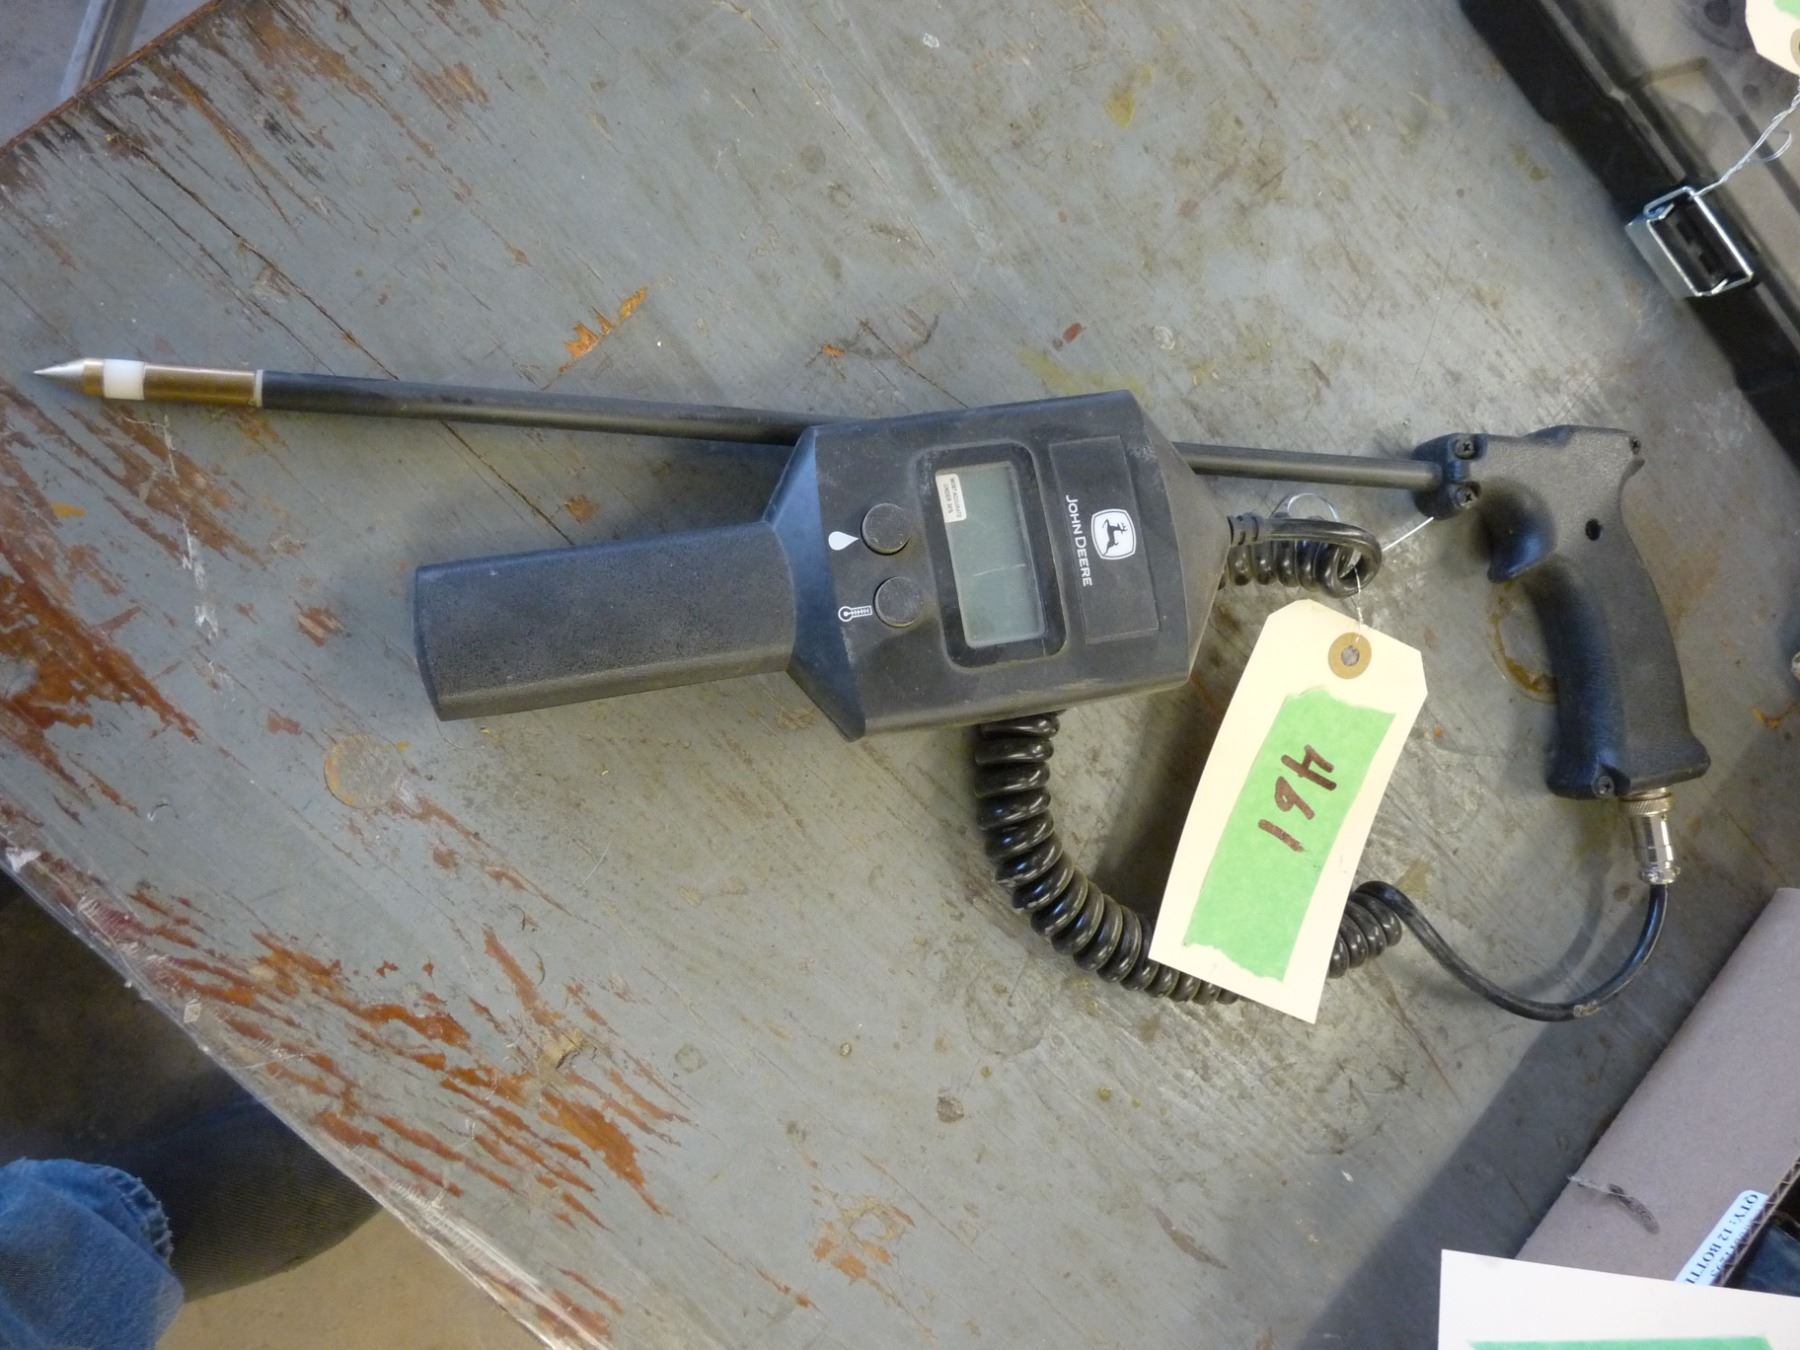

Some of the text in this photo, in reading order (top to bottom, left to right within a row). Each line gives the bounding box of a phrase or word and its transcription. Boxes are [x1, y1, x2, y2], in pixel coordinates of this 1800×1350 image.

[1065, 494, 1093, 587] JOHN DEERE
[1257, 743, 1337, 853] 461
[1717, 1228, 1733, 1242] 12
[1728, 1193, 1760, 1226] QTY:
